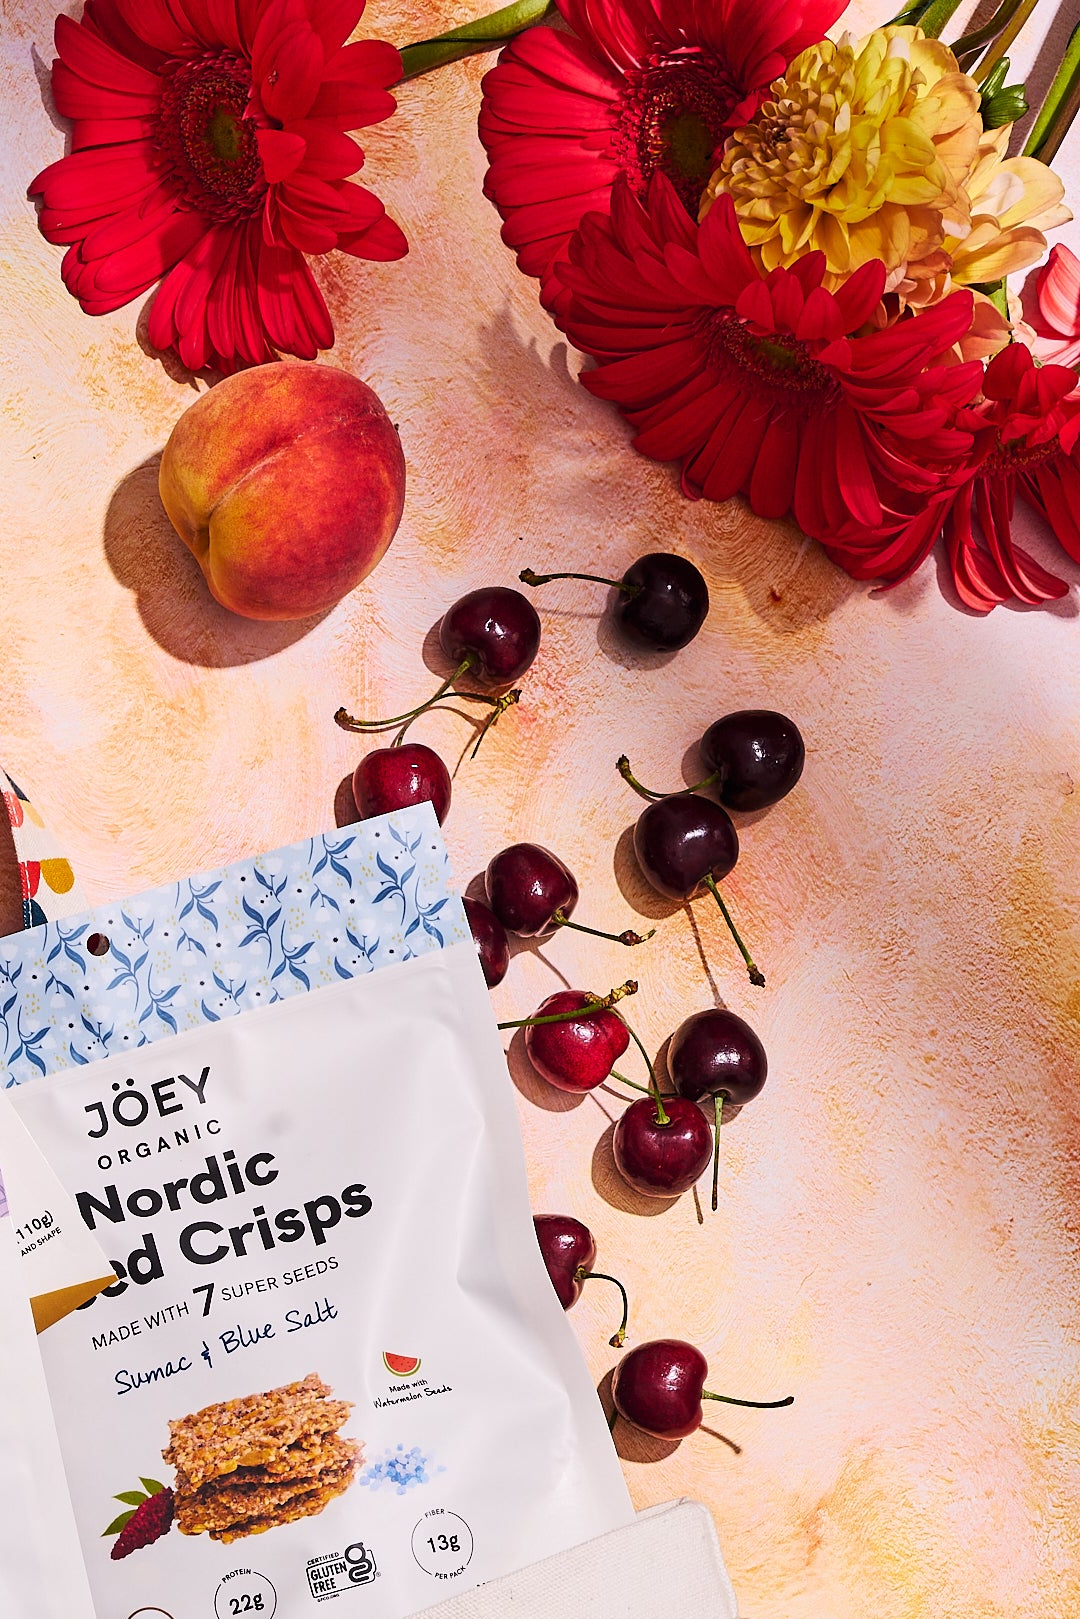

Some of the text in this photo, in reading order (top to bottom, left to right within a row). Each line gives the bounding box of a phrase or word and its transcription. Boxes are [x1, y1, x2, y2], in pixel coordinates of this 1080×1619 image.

[84, 1067, 211, 1139] JÖEY
[97, 1119, 221, 1170] ORGANIC
[75, 1149, 279, 1230] Nordic
[179, 1183, 372, 1265] Crisps
[21, 1227, 62, 1257] AND SHAPE
[92, 1256, 339, 1350] MADE WITH 7 SUPER SEEDS
[114, 1357, 192, 1395] Sumac
[220, 1323, 276, 1354] Blue
[286, 1298, 338, 1334] Salt
[373, 1385, 452, 1408] Watermelon Seeds
[389, 1379, 428, 1393] Made with
[424, 1508, 445, 1518] FIBER
[427, 1534, 461, 1553] 13g
[307, 1552, 339, 1566] CERTIFIED
[222, 1568, 251, 1583] PROTEIN
[310, 1561, 348, 1580] GLUTEN
[434, 1565, 466, 1580] PER PACK
[313, 1578, 336, 1593] FREE
[229, 1593, 265, 1615] 22g
